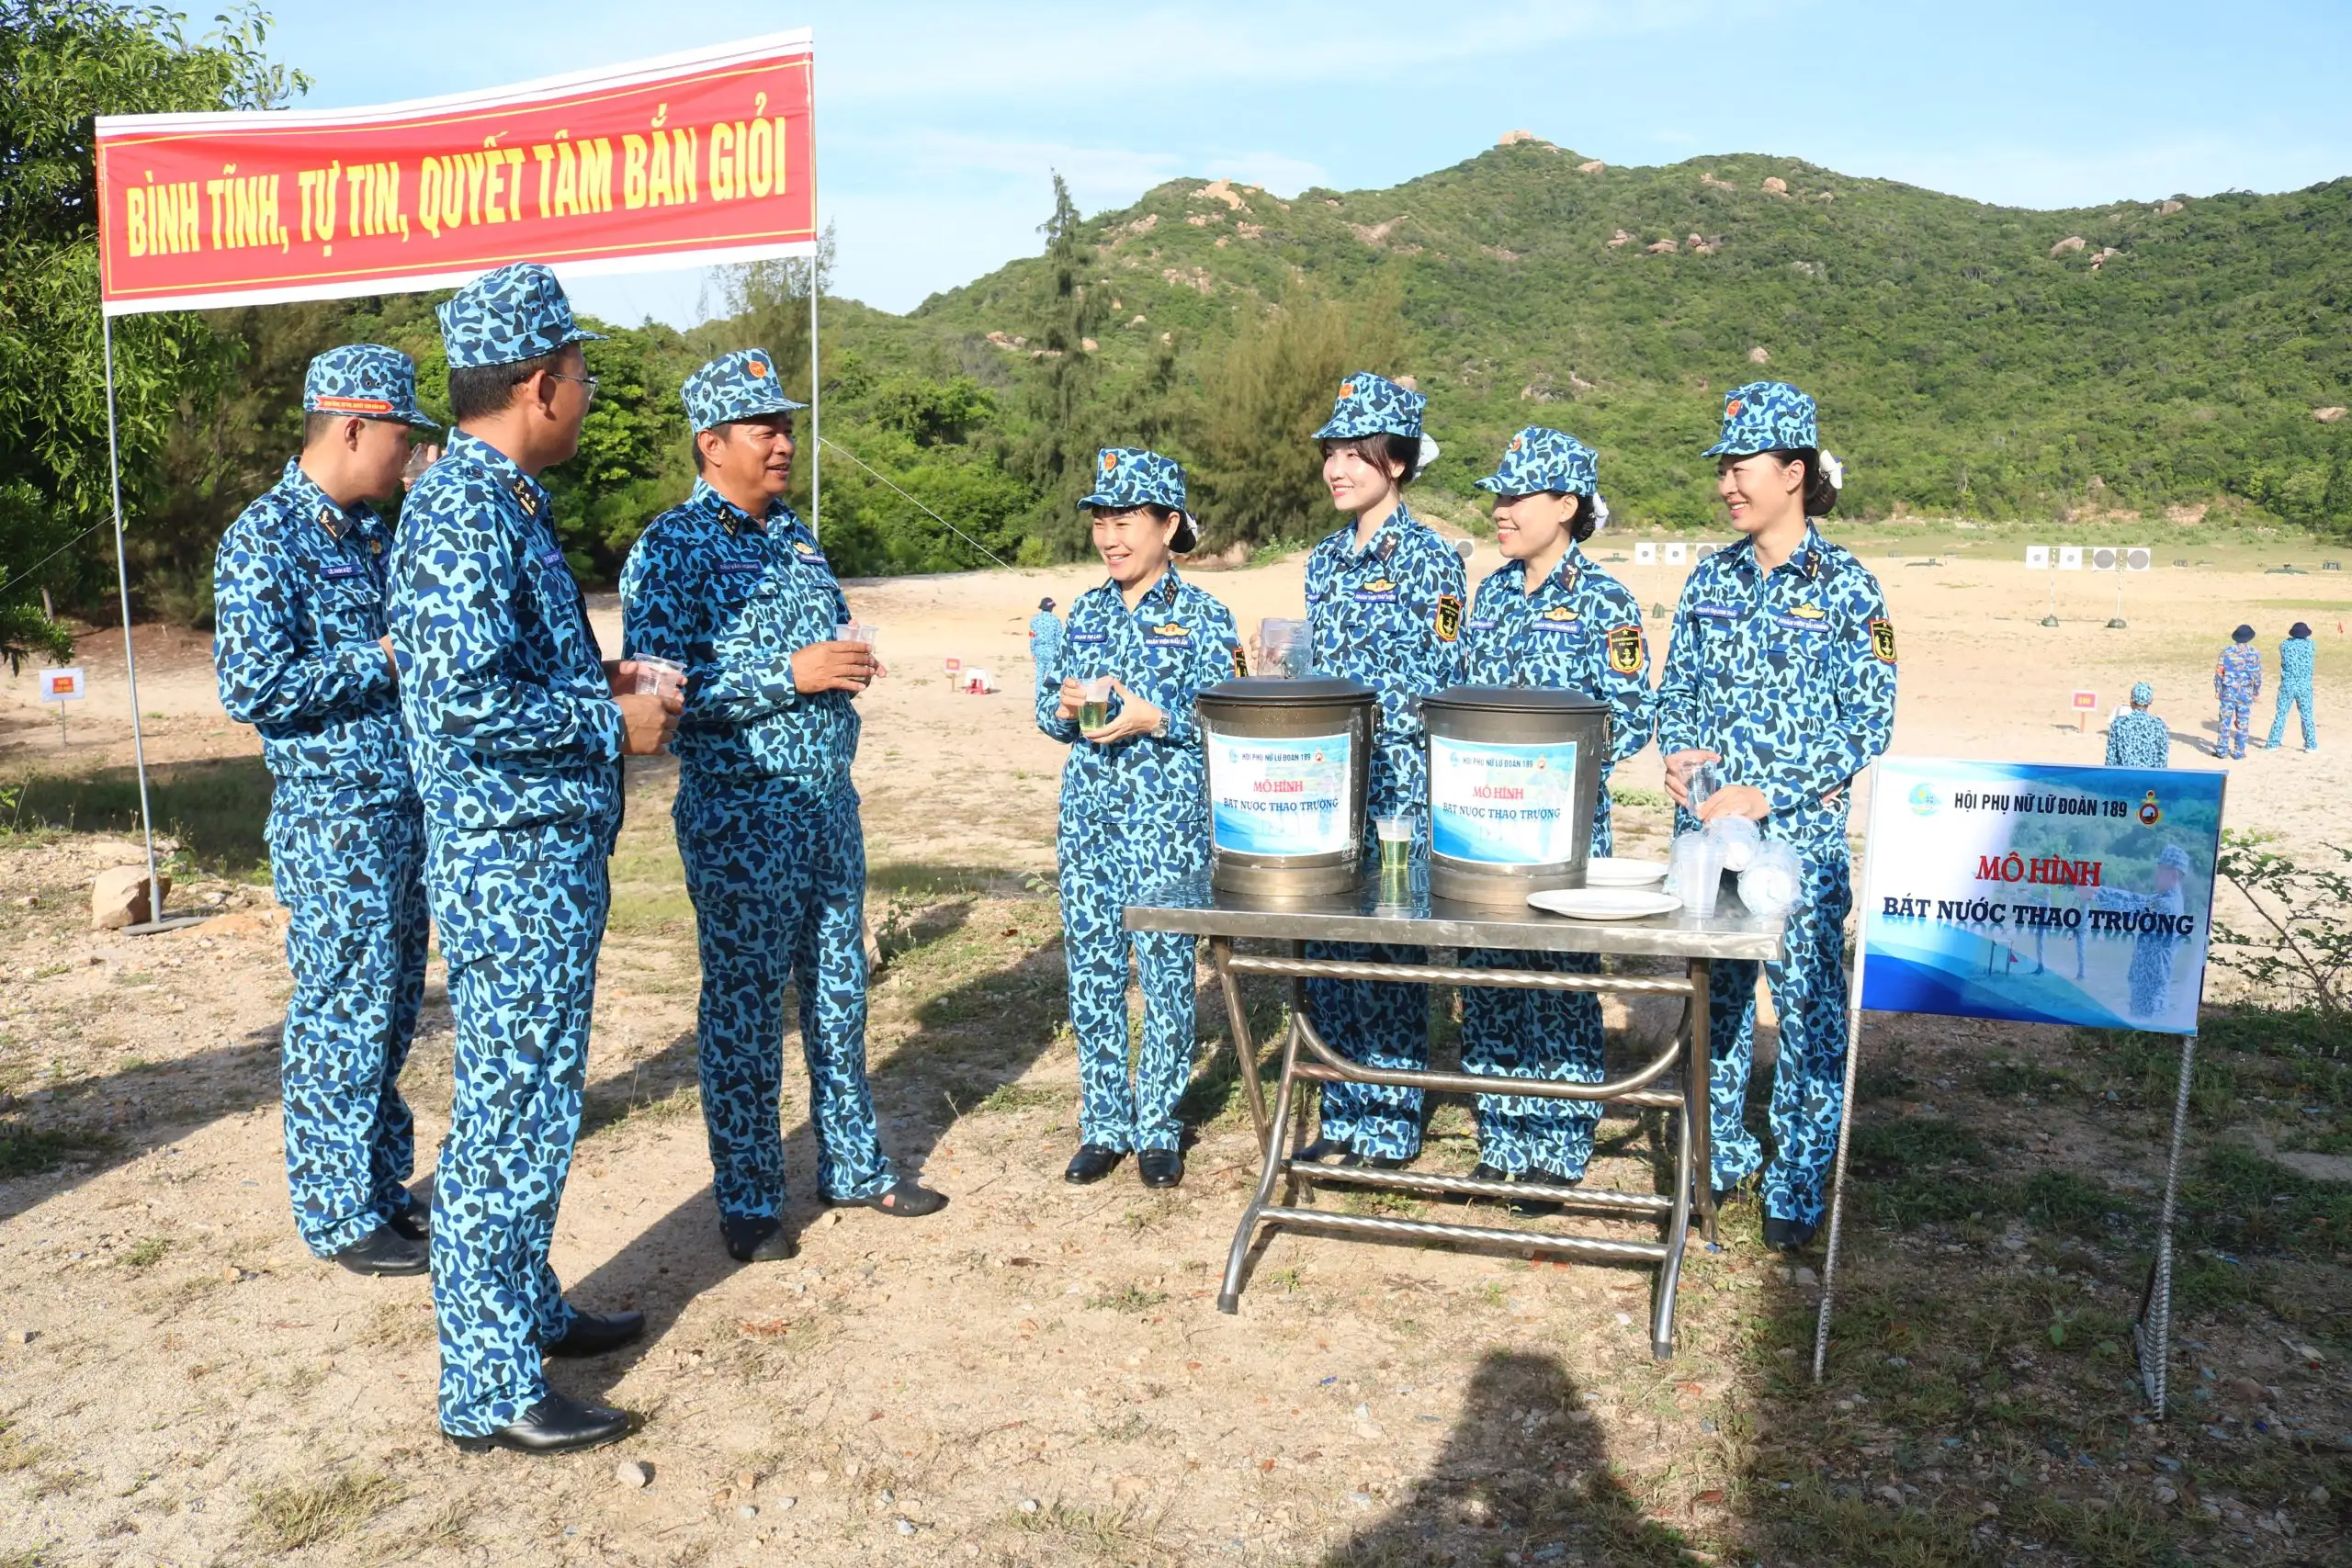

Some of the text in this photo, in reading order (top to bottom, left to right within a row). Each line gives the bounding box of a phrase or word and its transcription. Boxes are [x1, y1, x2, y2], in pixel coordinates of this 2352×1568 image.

[126, 91, 786, 257] BÌNH TĨNH, TỰ TIN, QUYẾT TÂM BẮN GIỎI
[1300, 752, 1311, 761] 189
[1522, 760, 1533, 769] 189
[1253, 778, 1272, 793] MÔ
[1472, 784, 1492, 799] MÔ
[1954, 790, 2128, 818] HỘI PHỤ NỮ LỮ ĐOÀN 189
[1975, 851, 2103, 886] MÔ HÌNH
[1883, 892, 2195, 935] BÁT NƯỚC THAO TRƯỜNG
